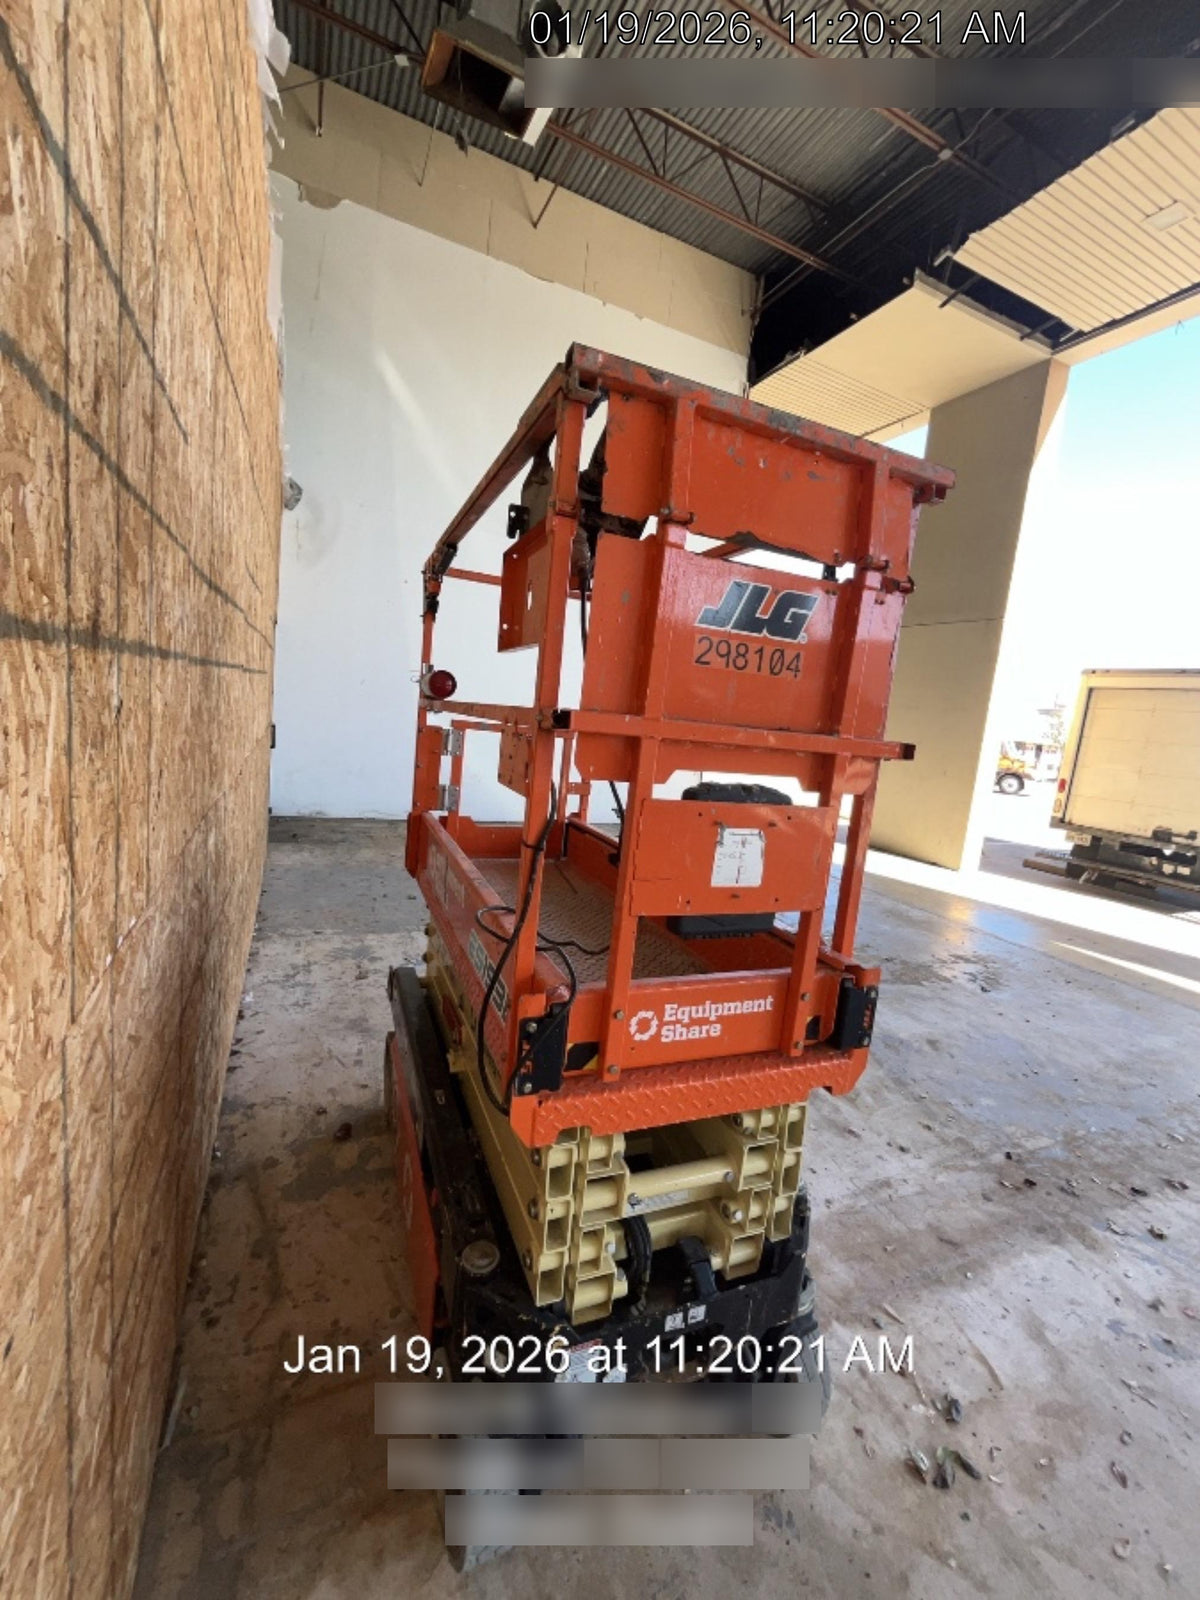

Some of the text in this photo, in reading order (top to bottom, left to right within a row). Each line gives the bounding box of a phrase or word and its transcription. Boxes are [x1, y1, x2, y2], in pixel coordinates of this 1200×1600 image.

[694, 578, 819, 643] JLG
[694, 636, 801, 678] 298104
[663, 995, 774, 1023] Equipment
[660, 1023, 722, 1042] Share
